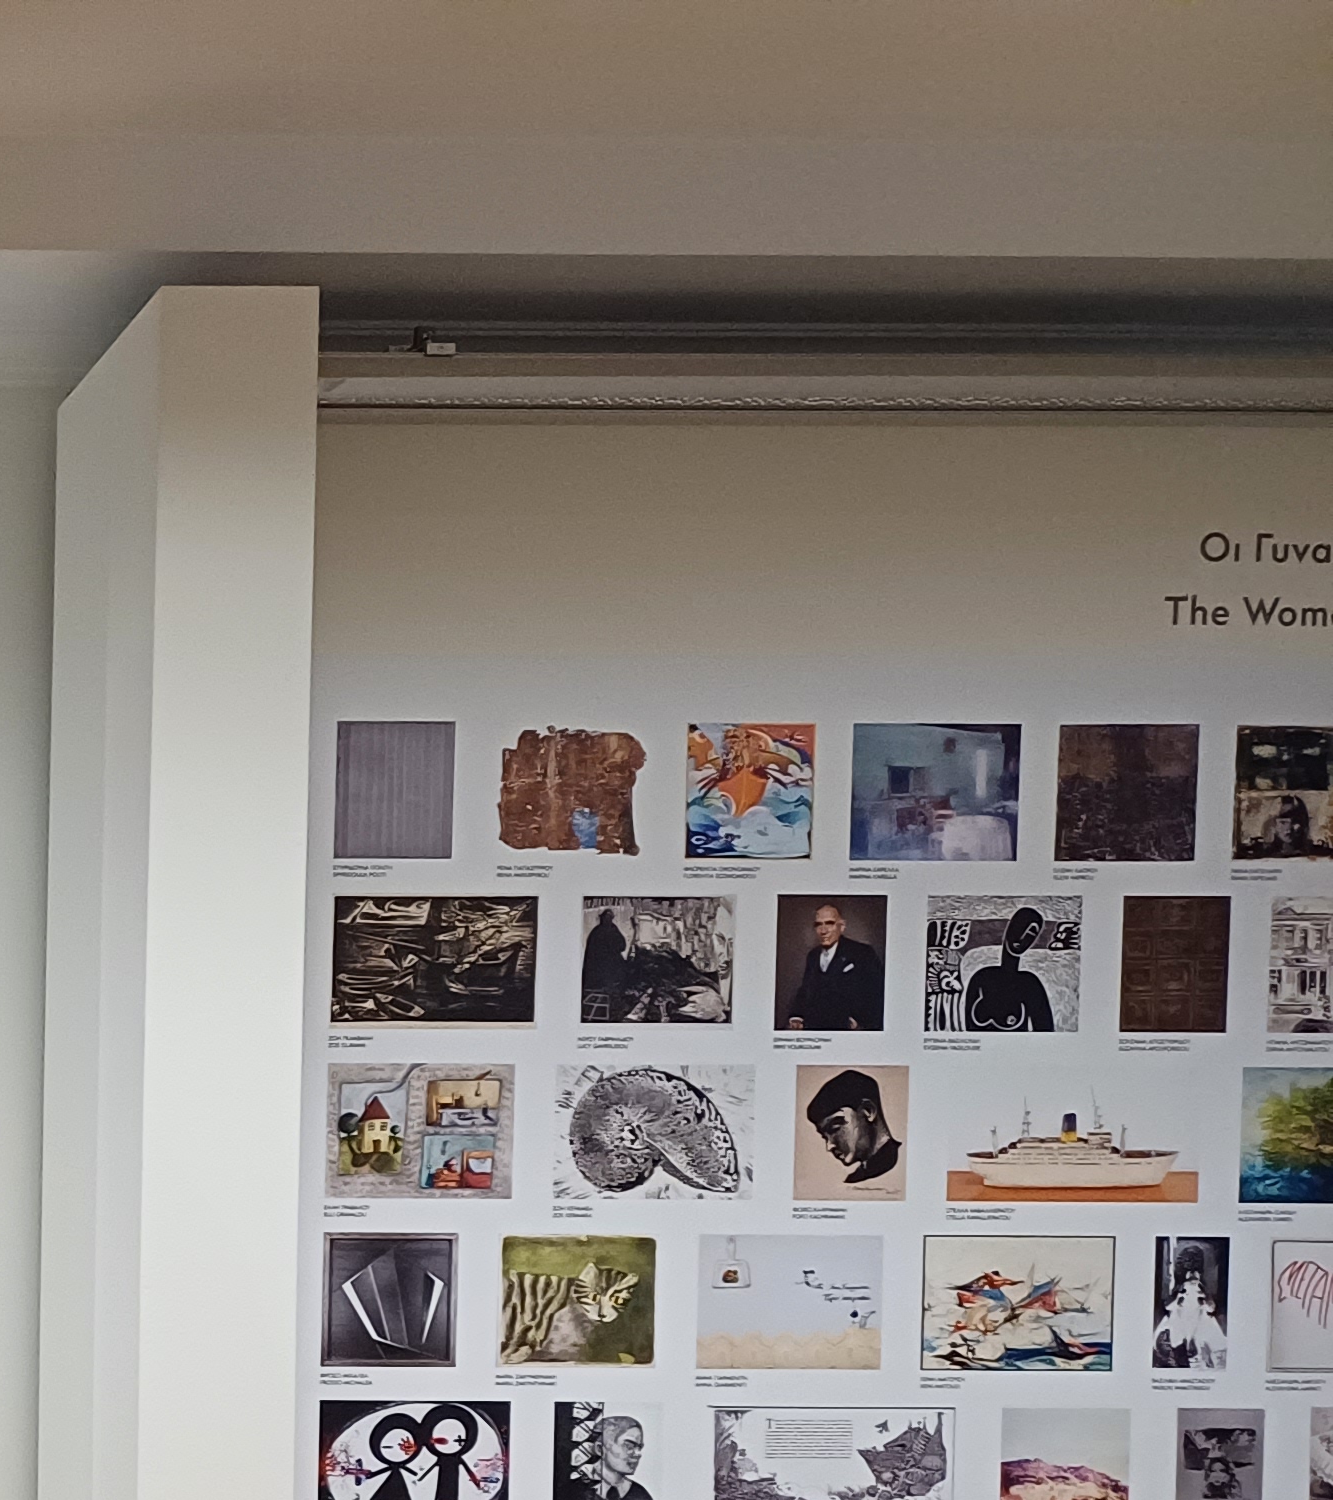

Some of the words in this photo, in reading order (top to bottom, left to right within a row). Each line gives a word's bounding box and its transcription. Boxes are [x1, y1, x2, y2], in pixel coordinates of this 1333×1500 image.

[1200, 532, 1240, 562] Οι
[1164, 594, 1229, 625] The
[1243, 597, 1333, 627] Wom
